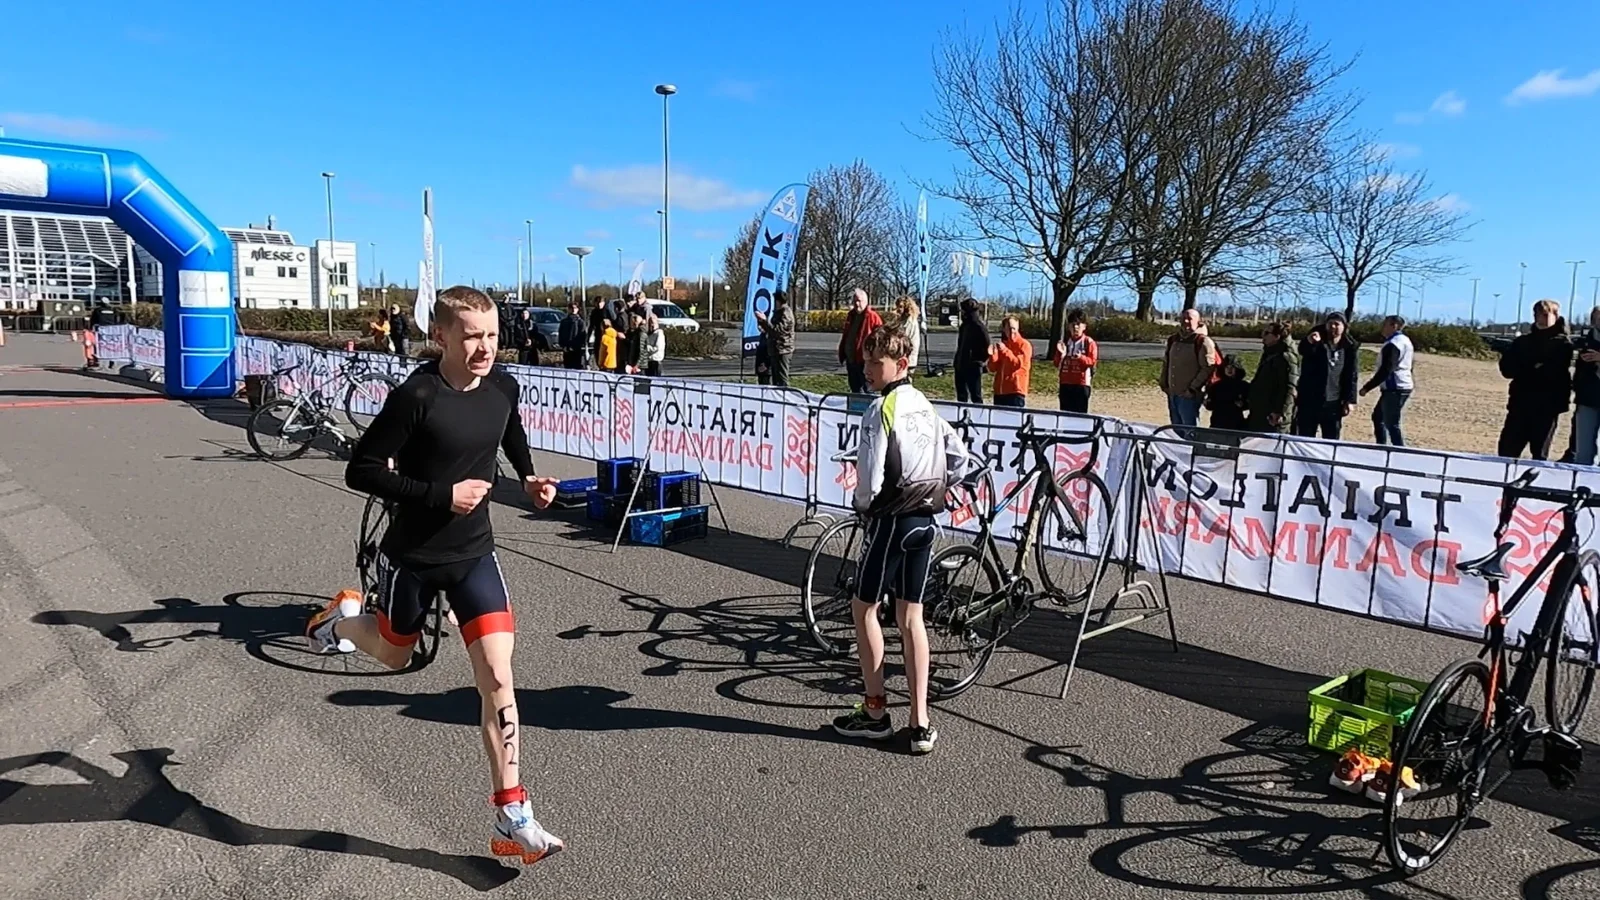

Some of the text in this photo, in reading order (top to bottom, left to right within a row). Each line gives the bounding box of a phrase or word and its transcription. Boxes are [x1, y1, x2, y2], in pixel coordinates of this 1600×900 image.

[251, 246, 306, 262] MESSE C
[753, 226, 784, 320] OTK
